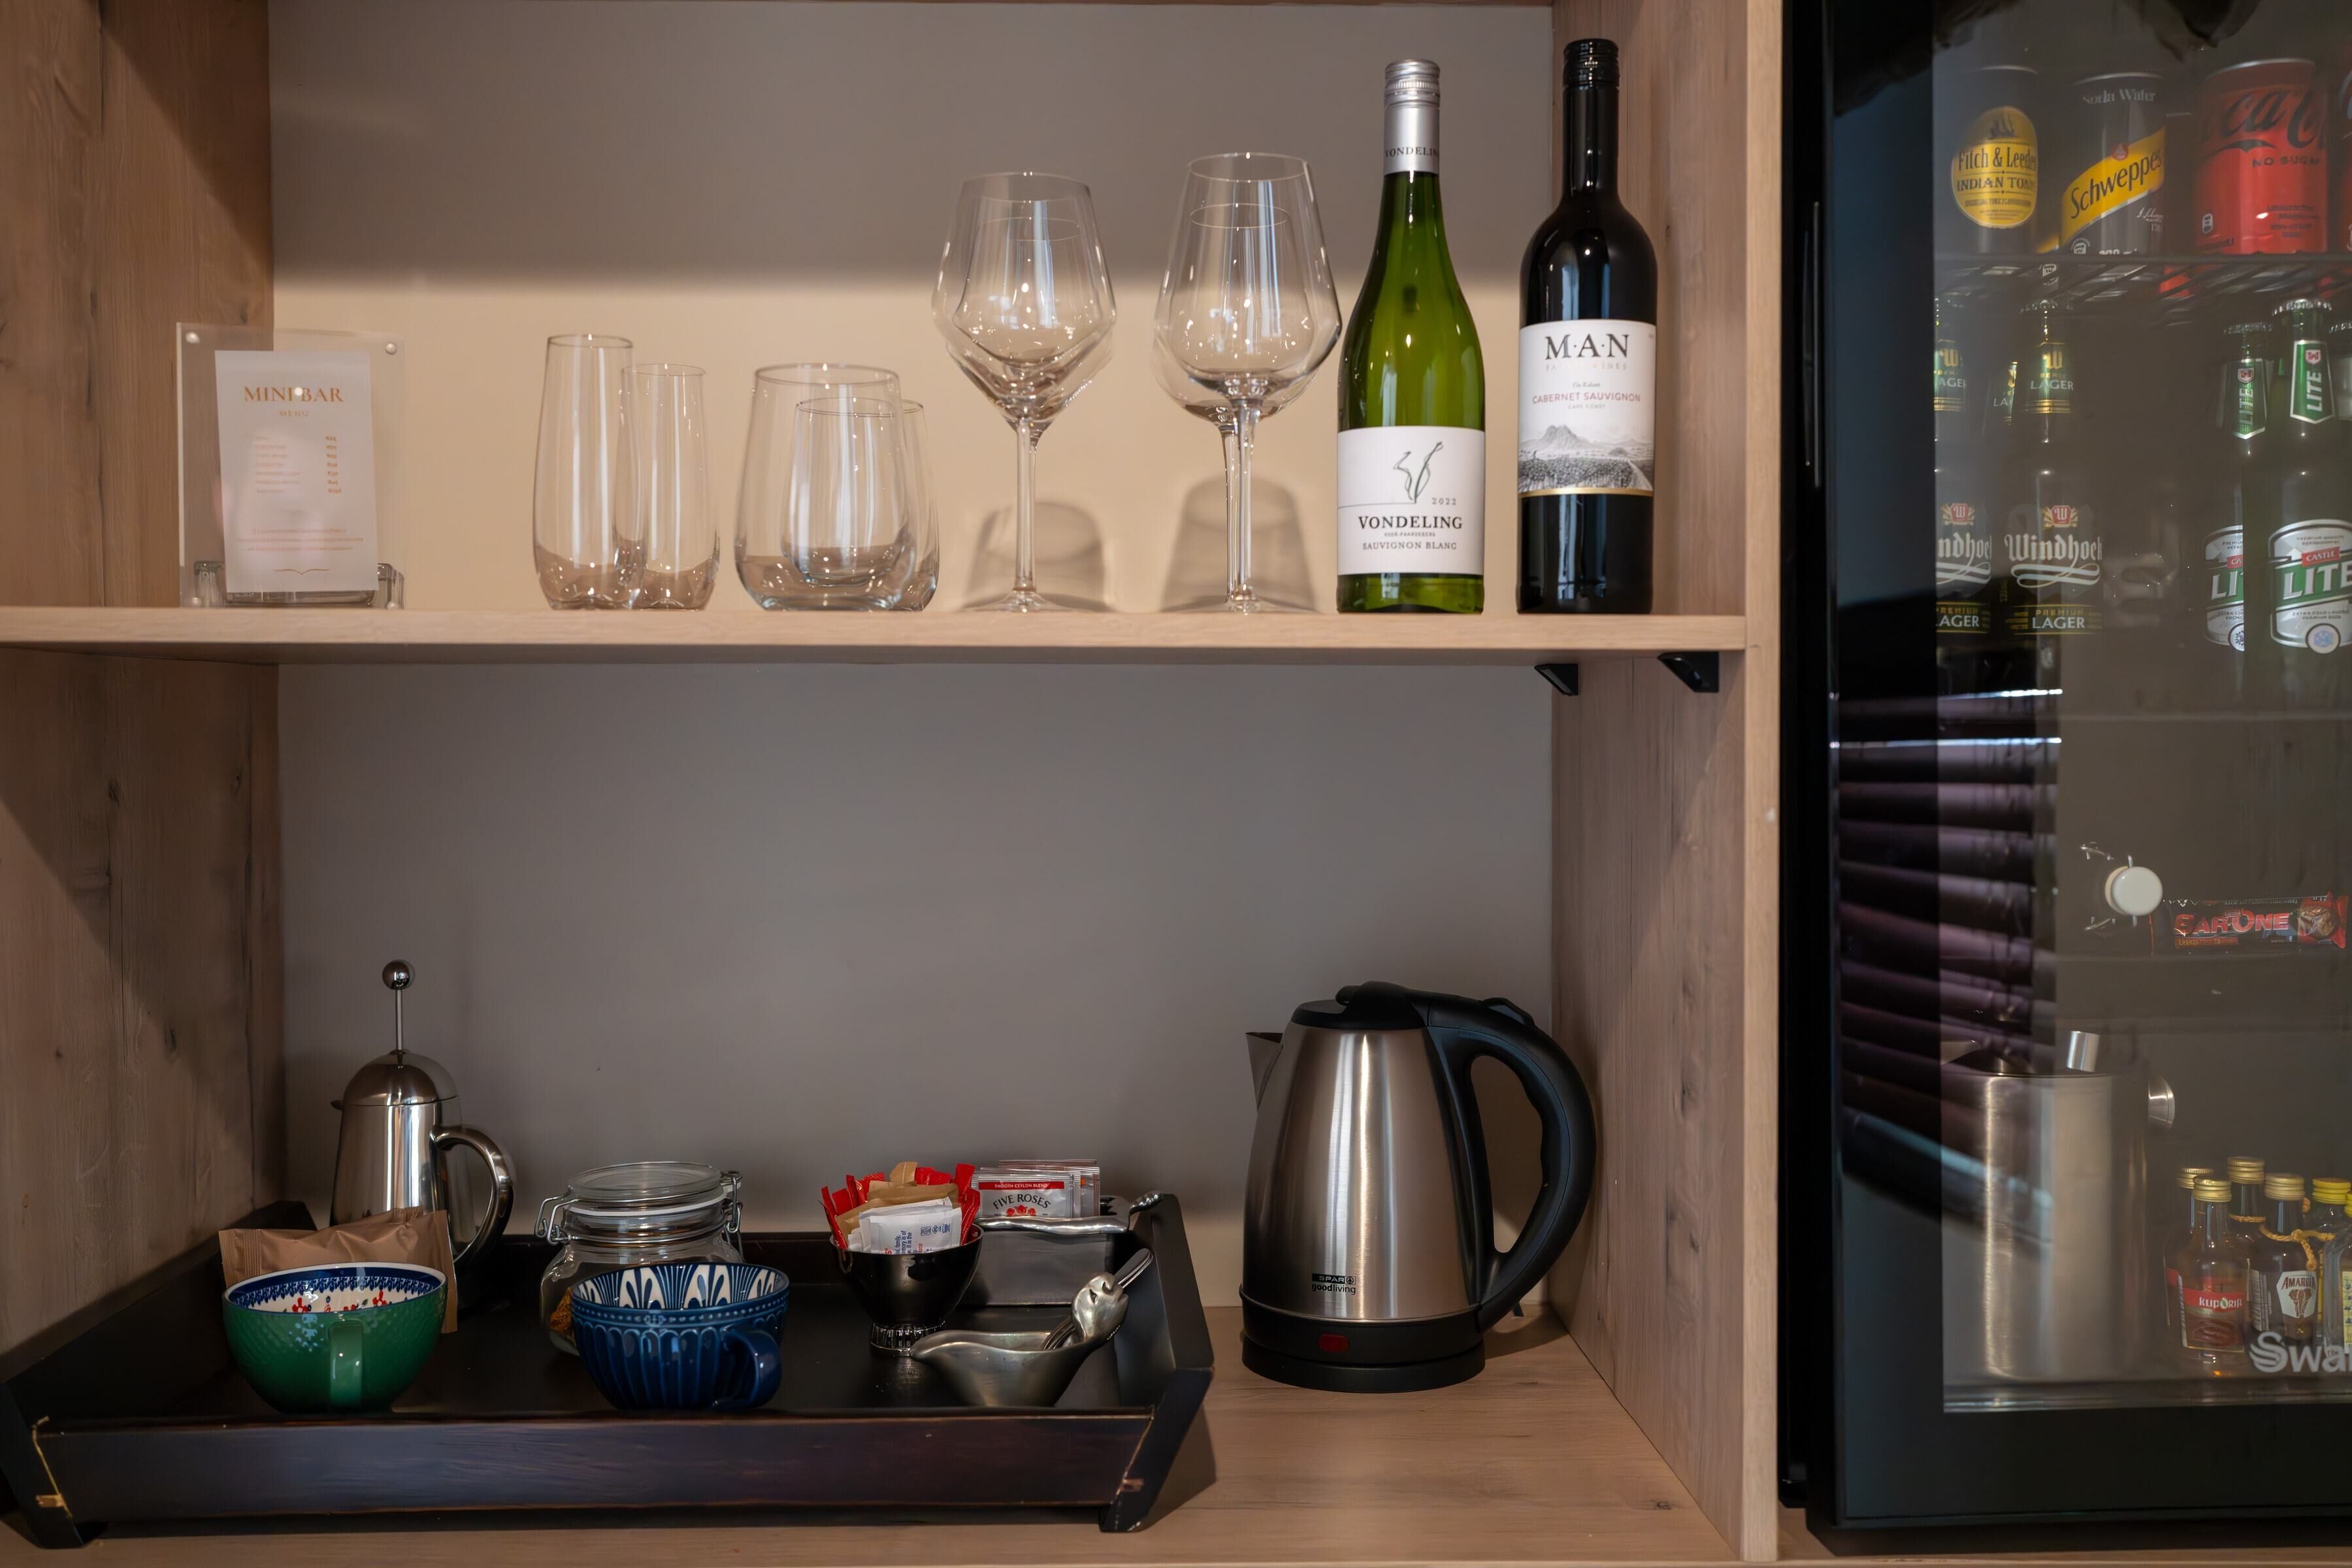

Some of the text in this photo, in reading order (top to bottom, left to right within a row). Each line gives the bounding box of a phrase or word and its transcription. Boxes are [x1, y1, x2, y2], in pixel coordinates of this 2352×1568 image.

[2119, 88, 2156, 102] Water
[1385, 146, 1439, 157] VONDELIN
[1958, 146, 2036, 171] Fitch & Leed
[2253, 157, 2274, 168] NO
[1957, 176, 2004, 192] INDIAN
[2070, 148, 2163, 220] Schweppes
[1938, 377, 1967, 389] AGE
[2031, 380, 2074, 391] LAGER
[244, 386, 344, 402] MINI BAR
[1532, 392, 1641, 404] CABERNET SAUVIGNON
[2306, 371, 2323, 412] LITE
[2238, 387, 2253, 425] LITE
[1431, 497, 1458, 506] 2022
[1358, 515, 1463, 530] VONDELING
[1362, 542, 1458, 550] SAUVIGNON BLANC
[1938, 531, 1992, 561] ndhoe
[2306, 551, 2336, 562] CASTLE
[2211, 570, 2244, 600] LI
[2283, 560, 2352, 600] LITE
[1936, 615, 1980, 628] AGER
[2032, 617, 2085, 629] LAGER
[992, 1194, 1051, 1210] FIVE ROSES
[2249, 1331, 2352, 1373] Swa
